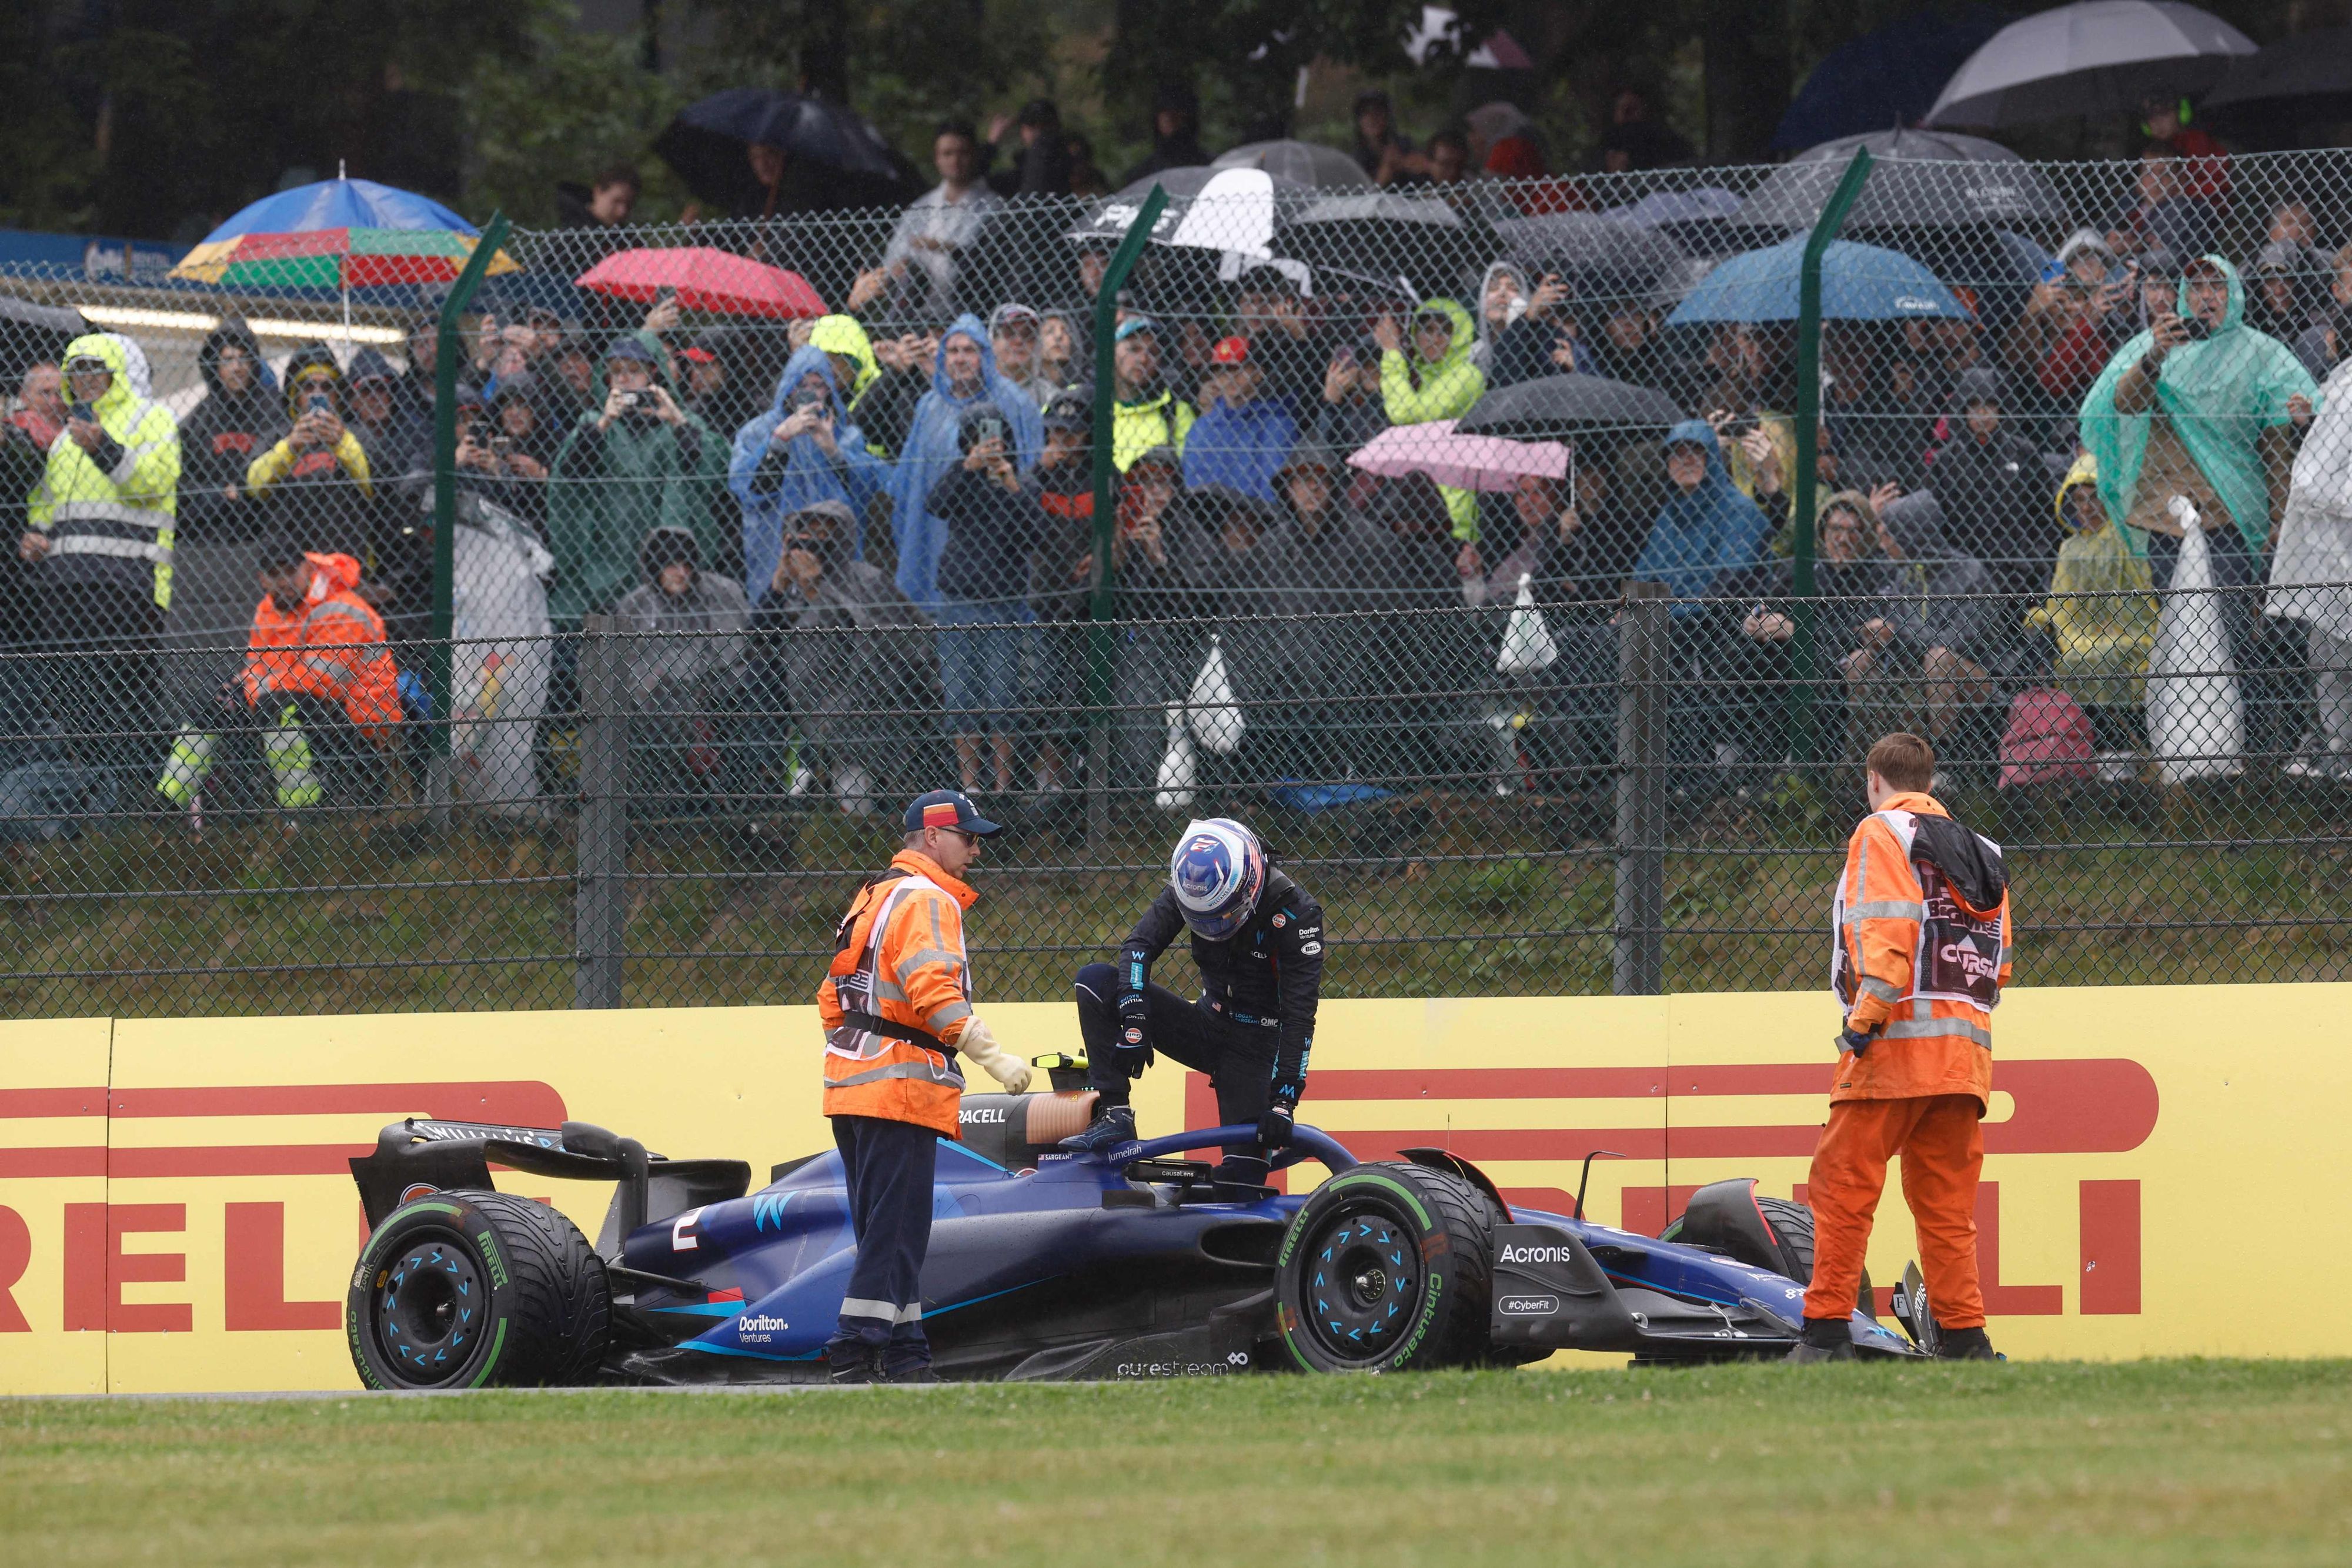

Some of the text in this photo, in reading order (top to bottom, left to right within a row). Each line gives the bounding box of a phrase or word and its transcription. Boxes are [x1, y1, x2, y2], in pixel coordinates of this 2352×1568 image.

[1120, 994, 1140, 1003] RACING
[1120, 998, 1143, 1009] WILLIAMS
[1261, 1017, 1278, 1027] OMP
[1108, 1145, 1142, 1164] Jumeirah
[1279, 1208, 1309, 1268] PIRELLI
[477, 1230, 509, 1288] PIRELLI
[1500, 1244, 1570, 1263] Acronis
[1508, 1300, 1549, 1311] #CyberFit
[1896, 1297, 1904, 1308] F
[739, 1333, 771, 1343] Ventures
